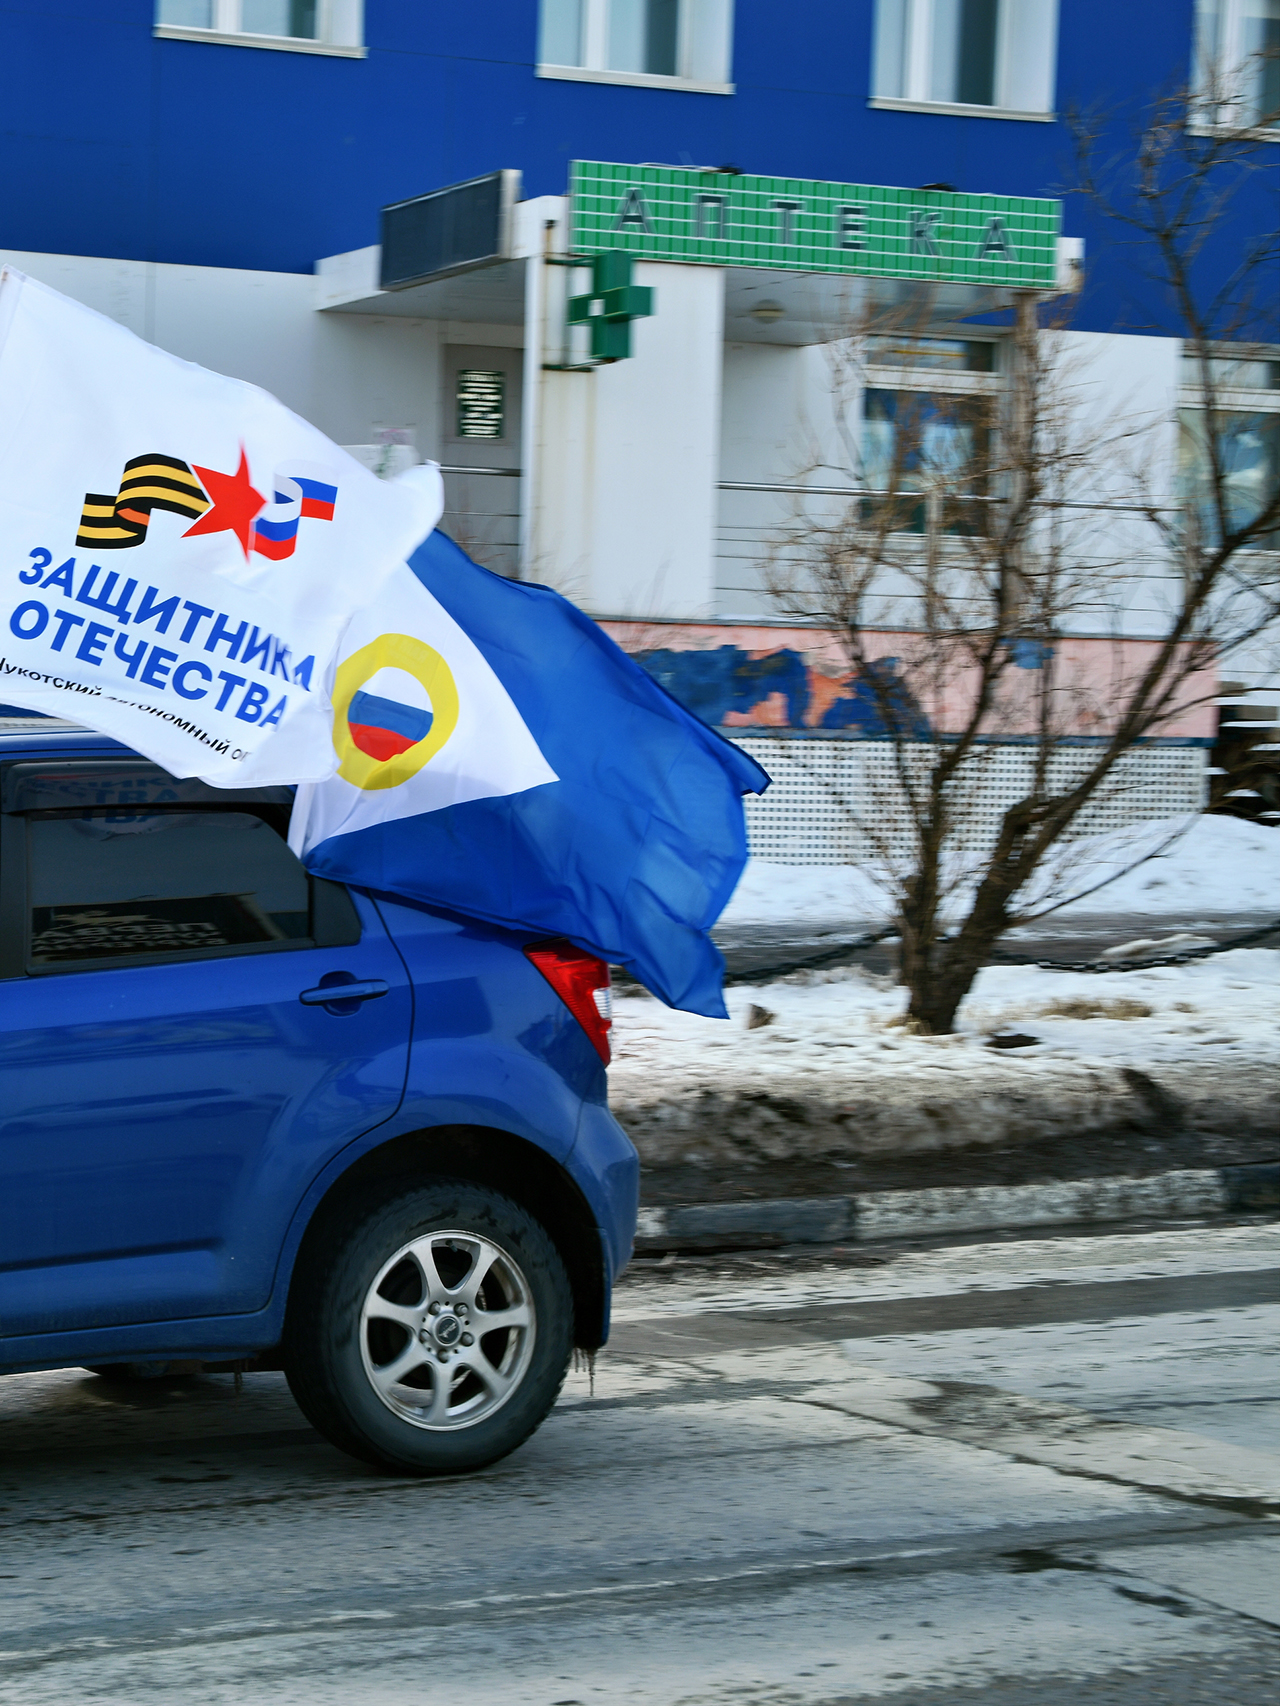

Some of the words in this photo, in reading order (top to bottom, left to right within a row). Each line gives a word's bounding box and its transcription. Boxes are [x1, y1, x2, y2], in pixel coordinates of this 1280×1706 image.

[609, 186, 1019, 263] АПТЕКА
[9, 600, 288, 731] ОТЕЧЕСТВА
[19, 546, 316, 692] ЗАЩИТНИКА
[105, 696, 231, 756] ономный
